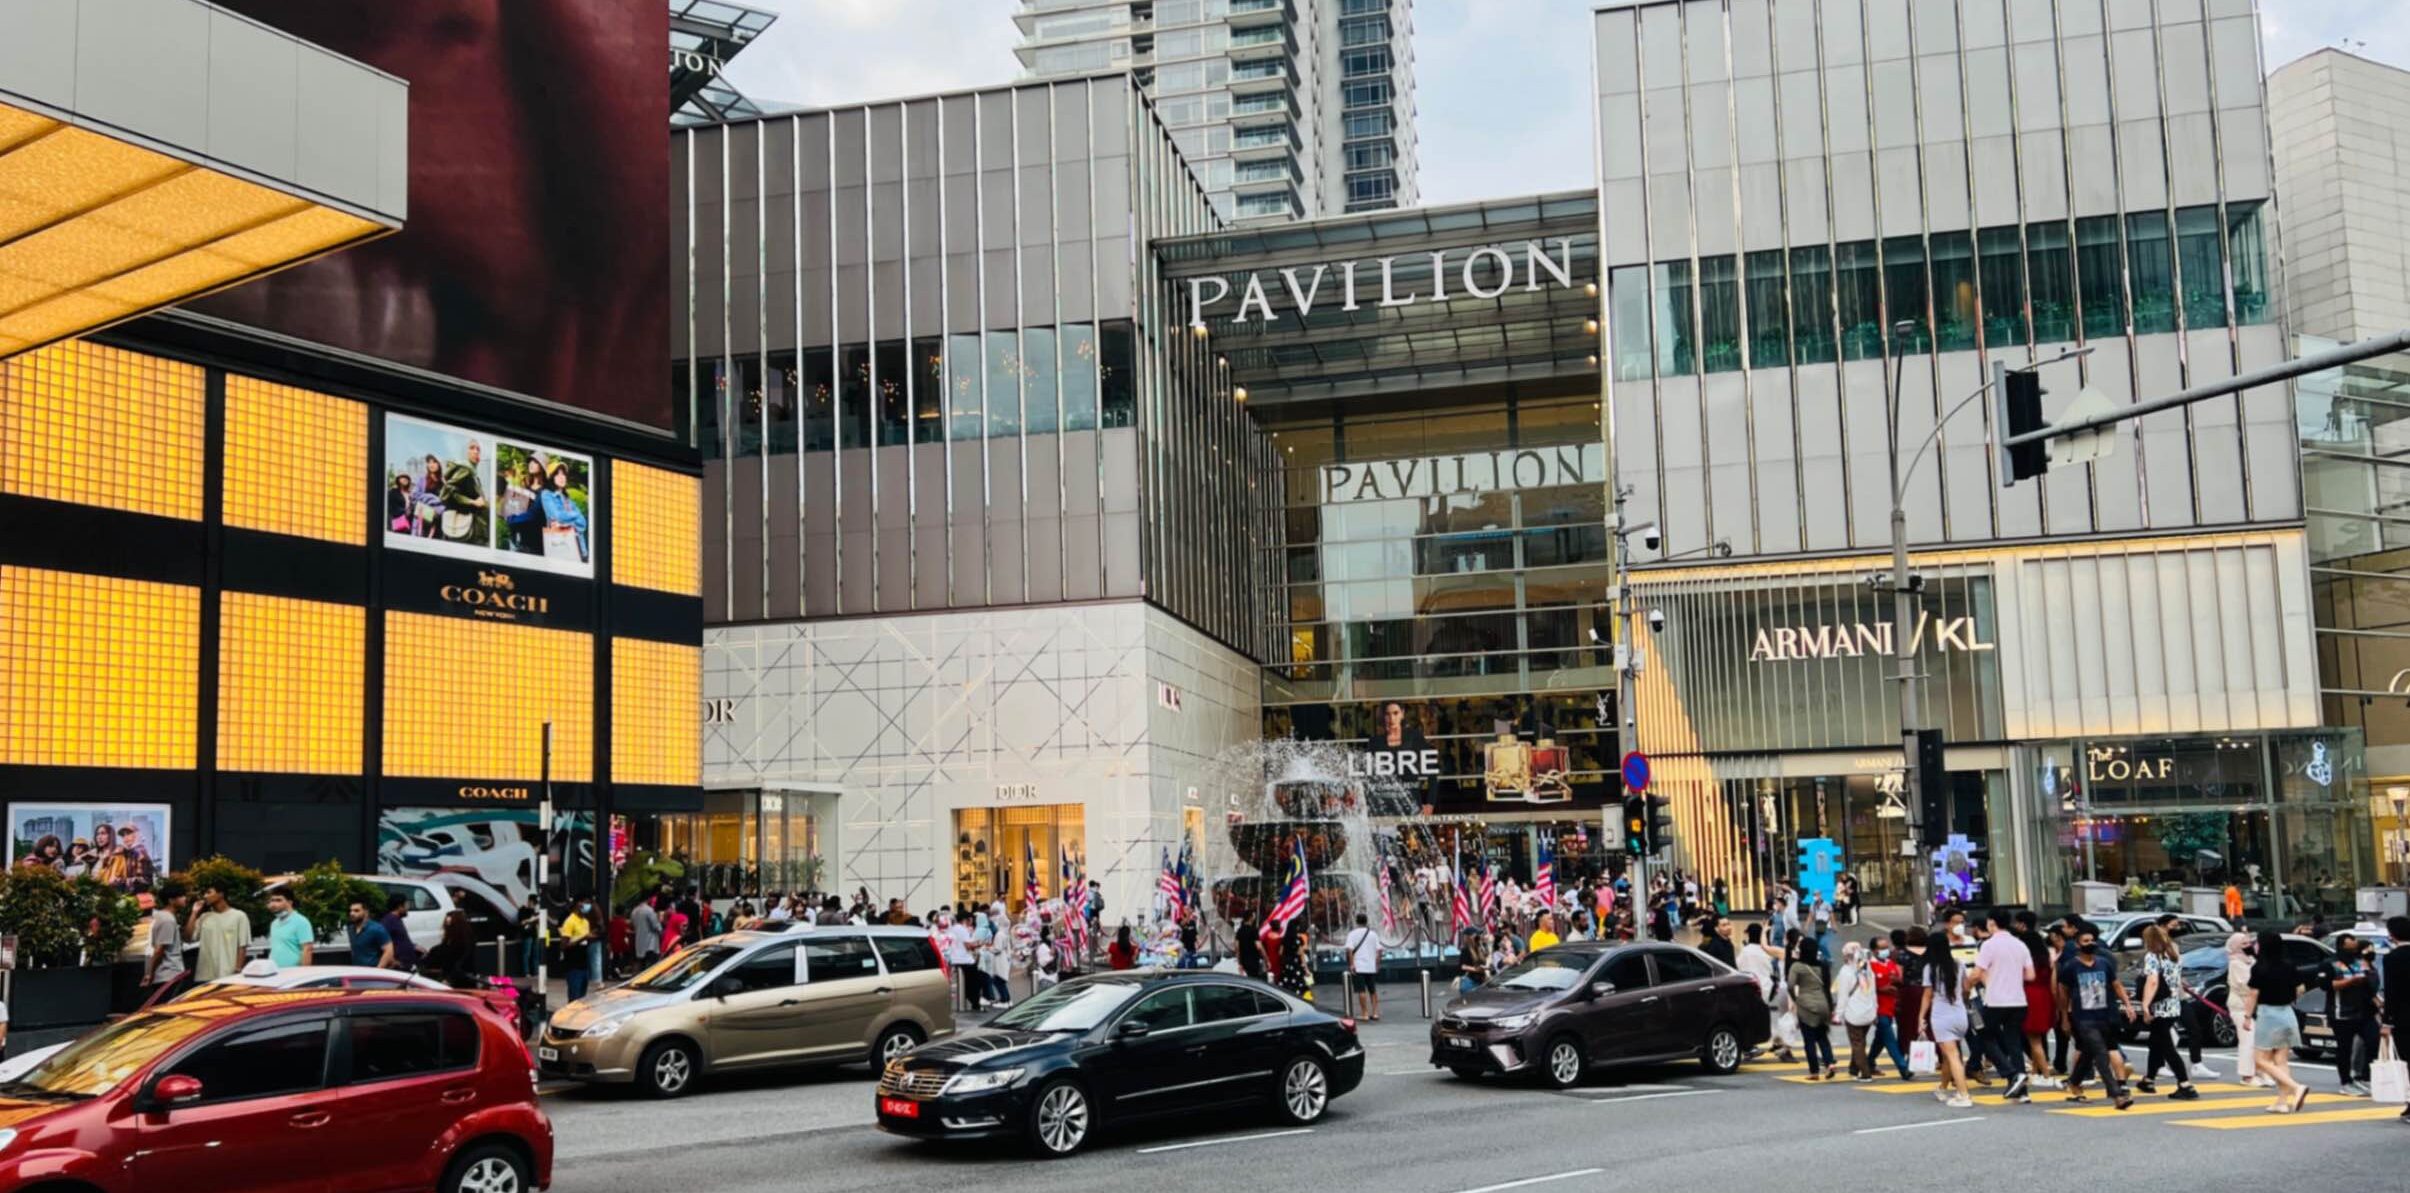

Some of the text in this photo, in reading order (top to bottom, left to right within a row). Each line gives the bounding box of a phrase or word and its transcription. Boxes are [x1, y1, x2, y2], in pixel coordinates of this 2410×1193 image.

[668, 48, 725, 76] ION
[1186, 237, 1573, 328] PAVILION
[1323, 444, 1586, 503] PAVILION
[440, 585, 549, 614] COACH
[1749, 622, 1895, 661] ARMANI
[1936, 616, 1995, 653] KL
[1346, 749, 1440, 778] LIBRE
[2087, 757, 2175, 781] LOAF
[458, 786, 529, 799] COACH
[994, 783, 1040, 801] DIOR
